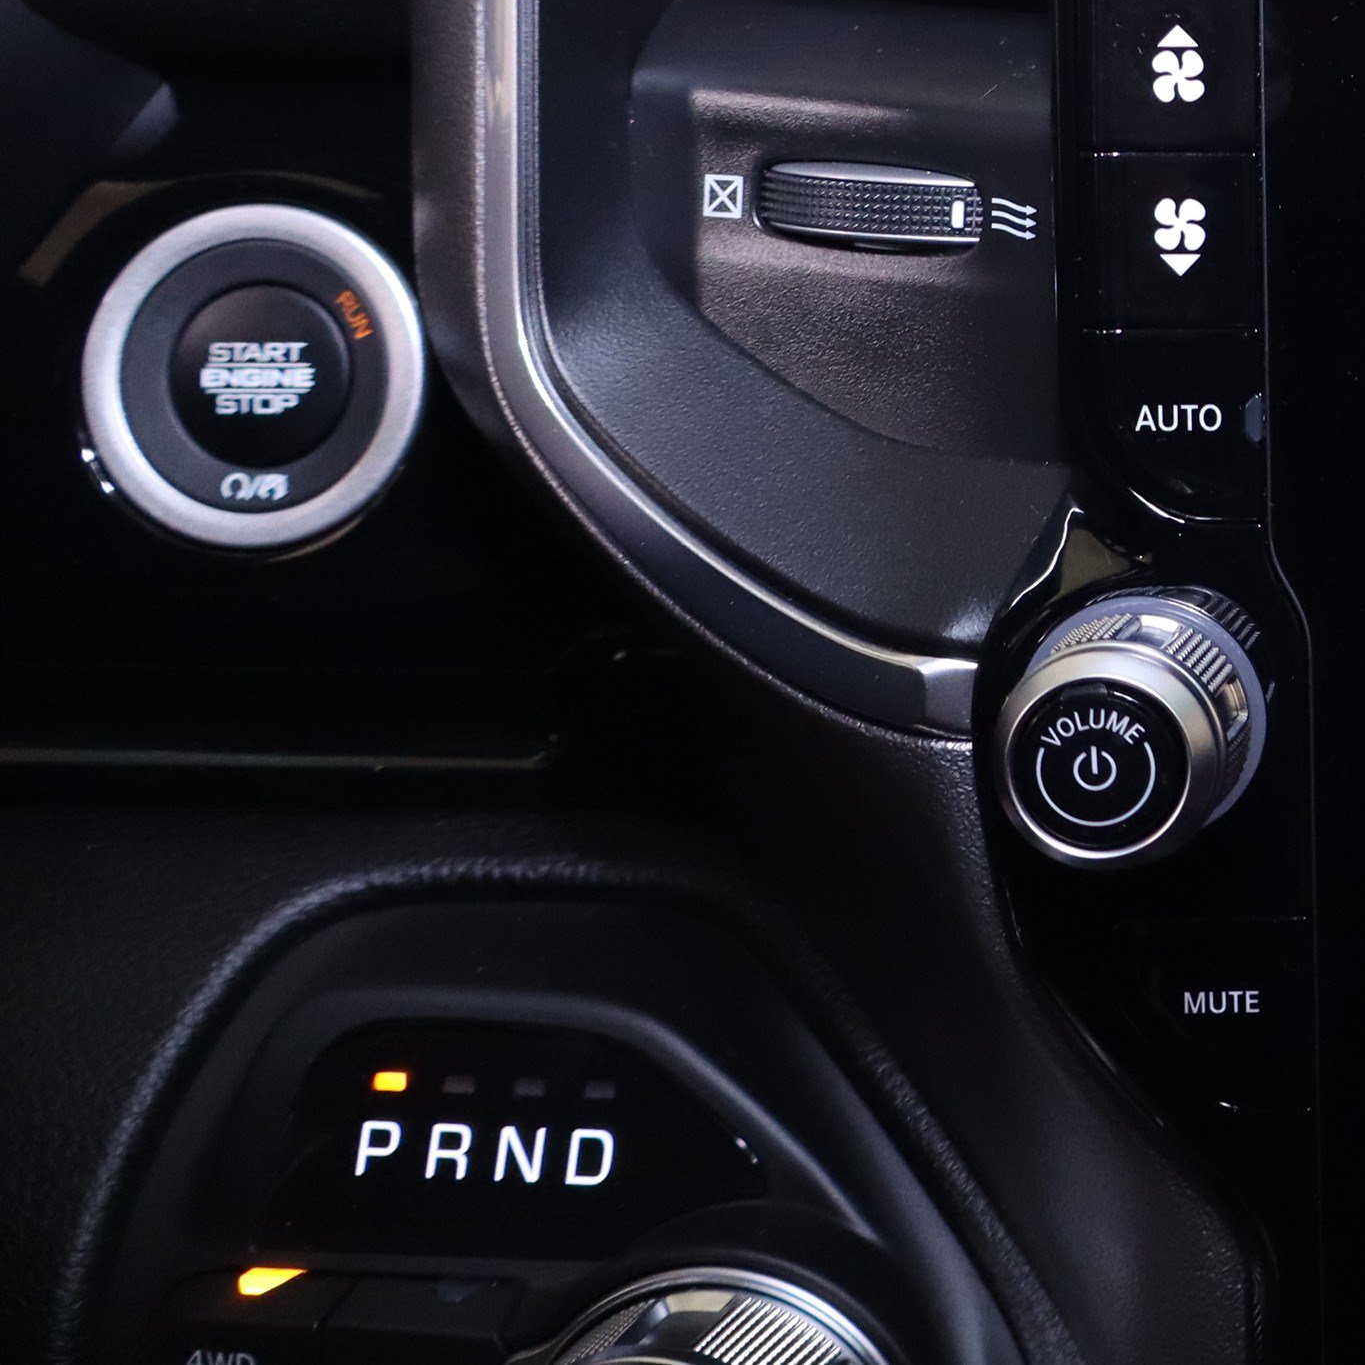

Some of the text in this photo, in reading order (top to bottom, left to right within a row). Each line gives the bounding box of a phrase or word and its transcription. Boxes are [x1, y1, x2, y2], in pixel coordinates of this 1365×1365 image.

[333, 288, 374, 341] RUN
[208, 342, 309, 363] START
[199, 367, 316, 387] ENGINE
[215, 394, 300, 414] STOP
[1134, 404, 1222, 432] AUTO
[1040, 708, 1145, 748] VOLUME
[1184, 991, 1260, 1013] MUTE
